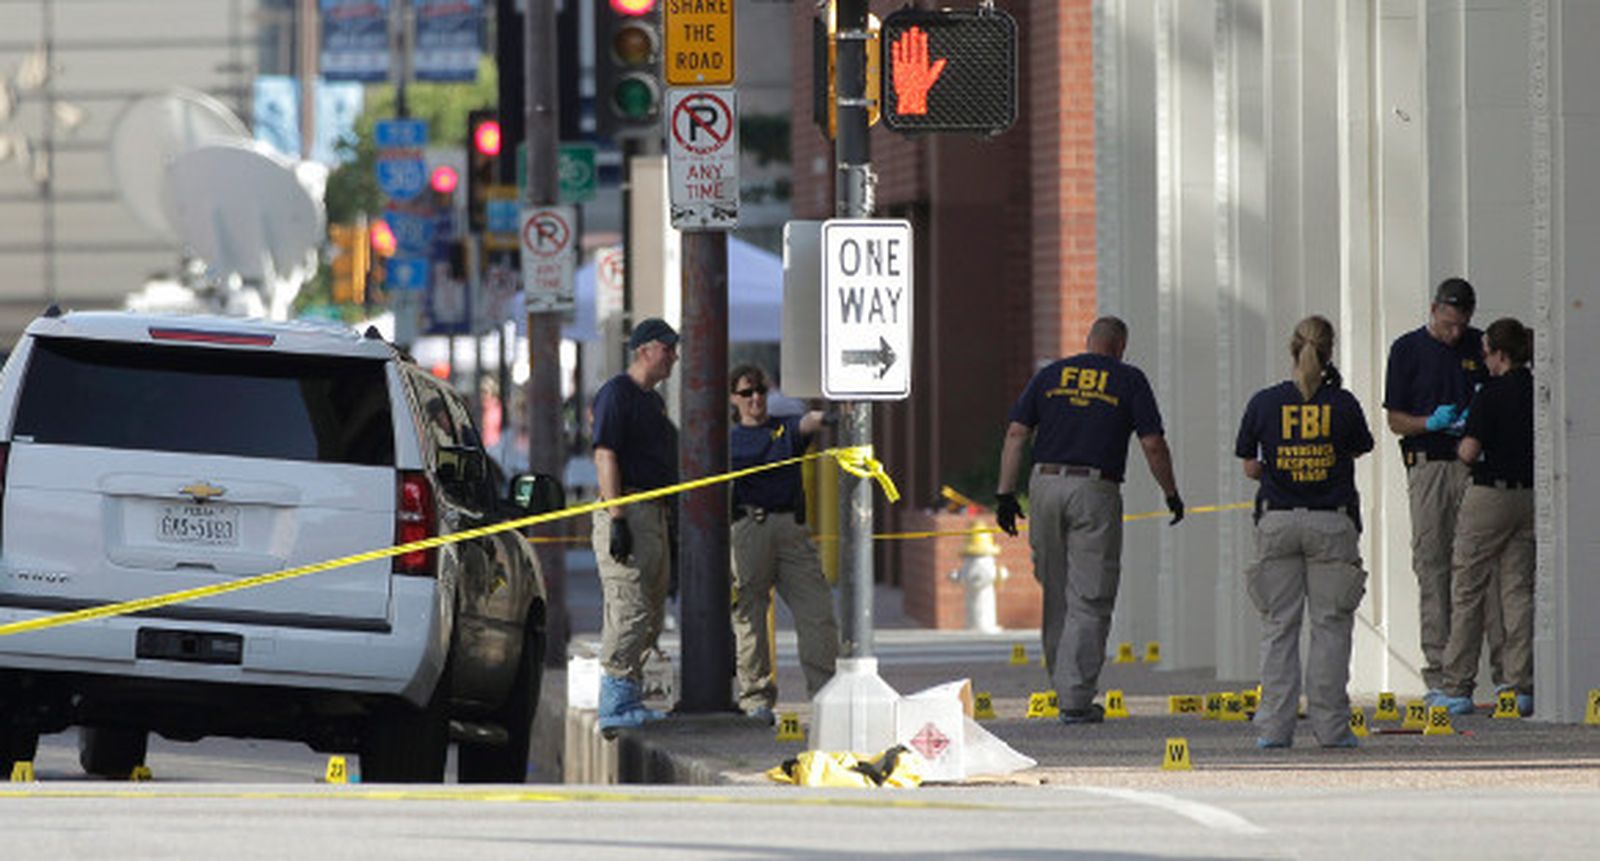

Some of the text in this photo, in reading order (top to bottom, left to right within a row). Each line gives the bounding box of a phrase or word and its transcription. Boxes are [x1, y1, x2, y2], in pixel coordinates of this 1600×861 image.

[671, 0, 728, 14] SHARE
[684, 24, 715, 41] THE
[676, 52, 722, 69] ROAD
[687, 164, 724, 180] ANY
[685, 181, 725, 200] TIME
[839, 238, 901, 276] ONE
[838, 287, 902, 324] WAY
[1061, 366, 1109, 392] FBI
[1282, 404, 1331, 440] FBI
[1169, 744, 1184, 761] W
